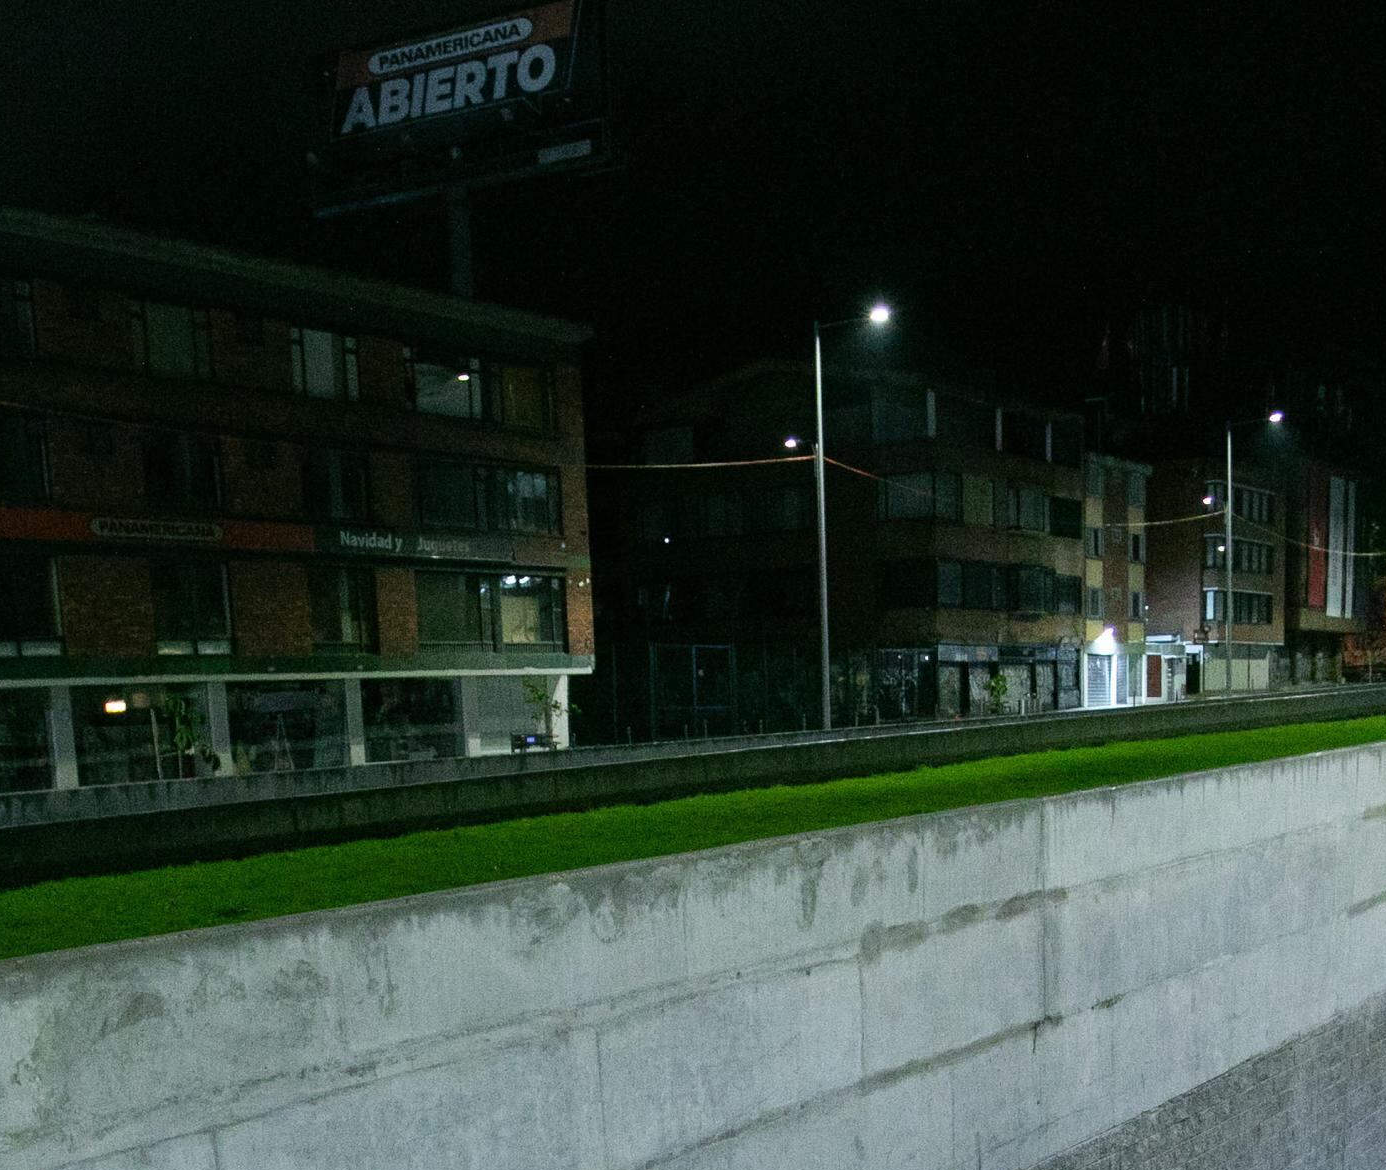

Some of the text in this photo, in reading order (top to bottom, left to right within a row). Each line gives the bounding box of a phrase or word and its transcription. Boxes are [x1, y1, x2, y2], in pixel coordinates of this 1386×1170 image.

[379, 23, 520, 70] PANAMERICANA
[340, 43, 556, 135] ABIERTO
[340, 530, 392, 550] Navidad
[394, 537, 403, 552] y
